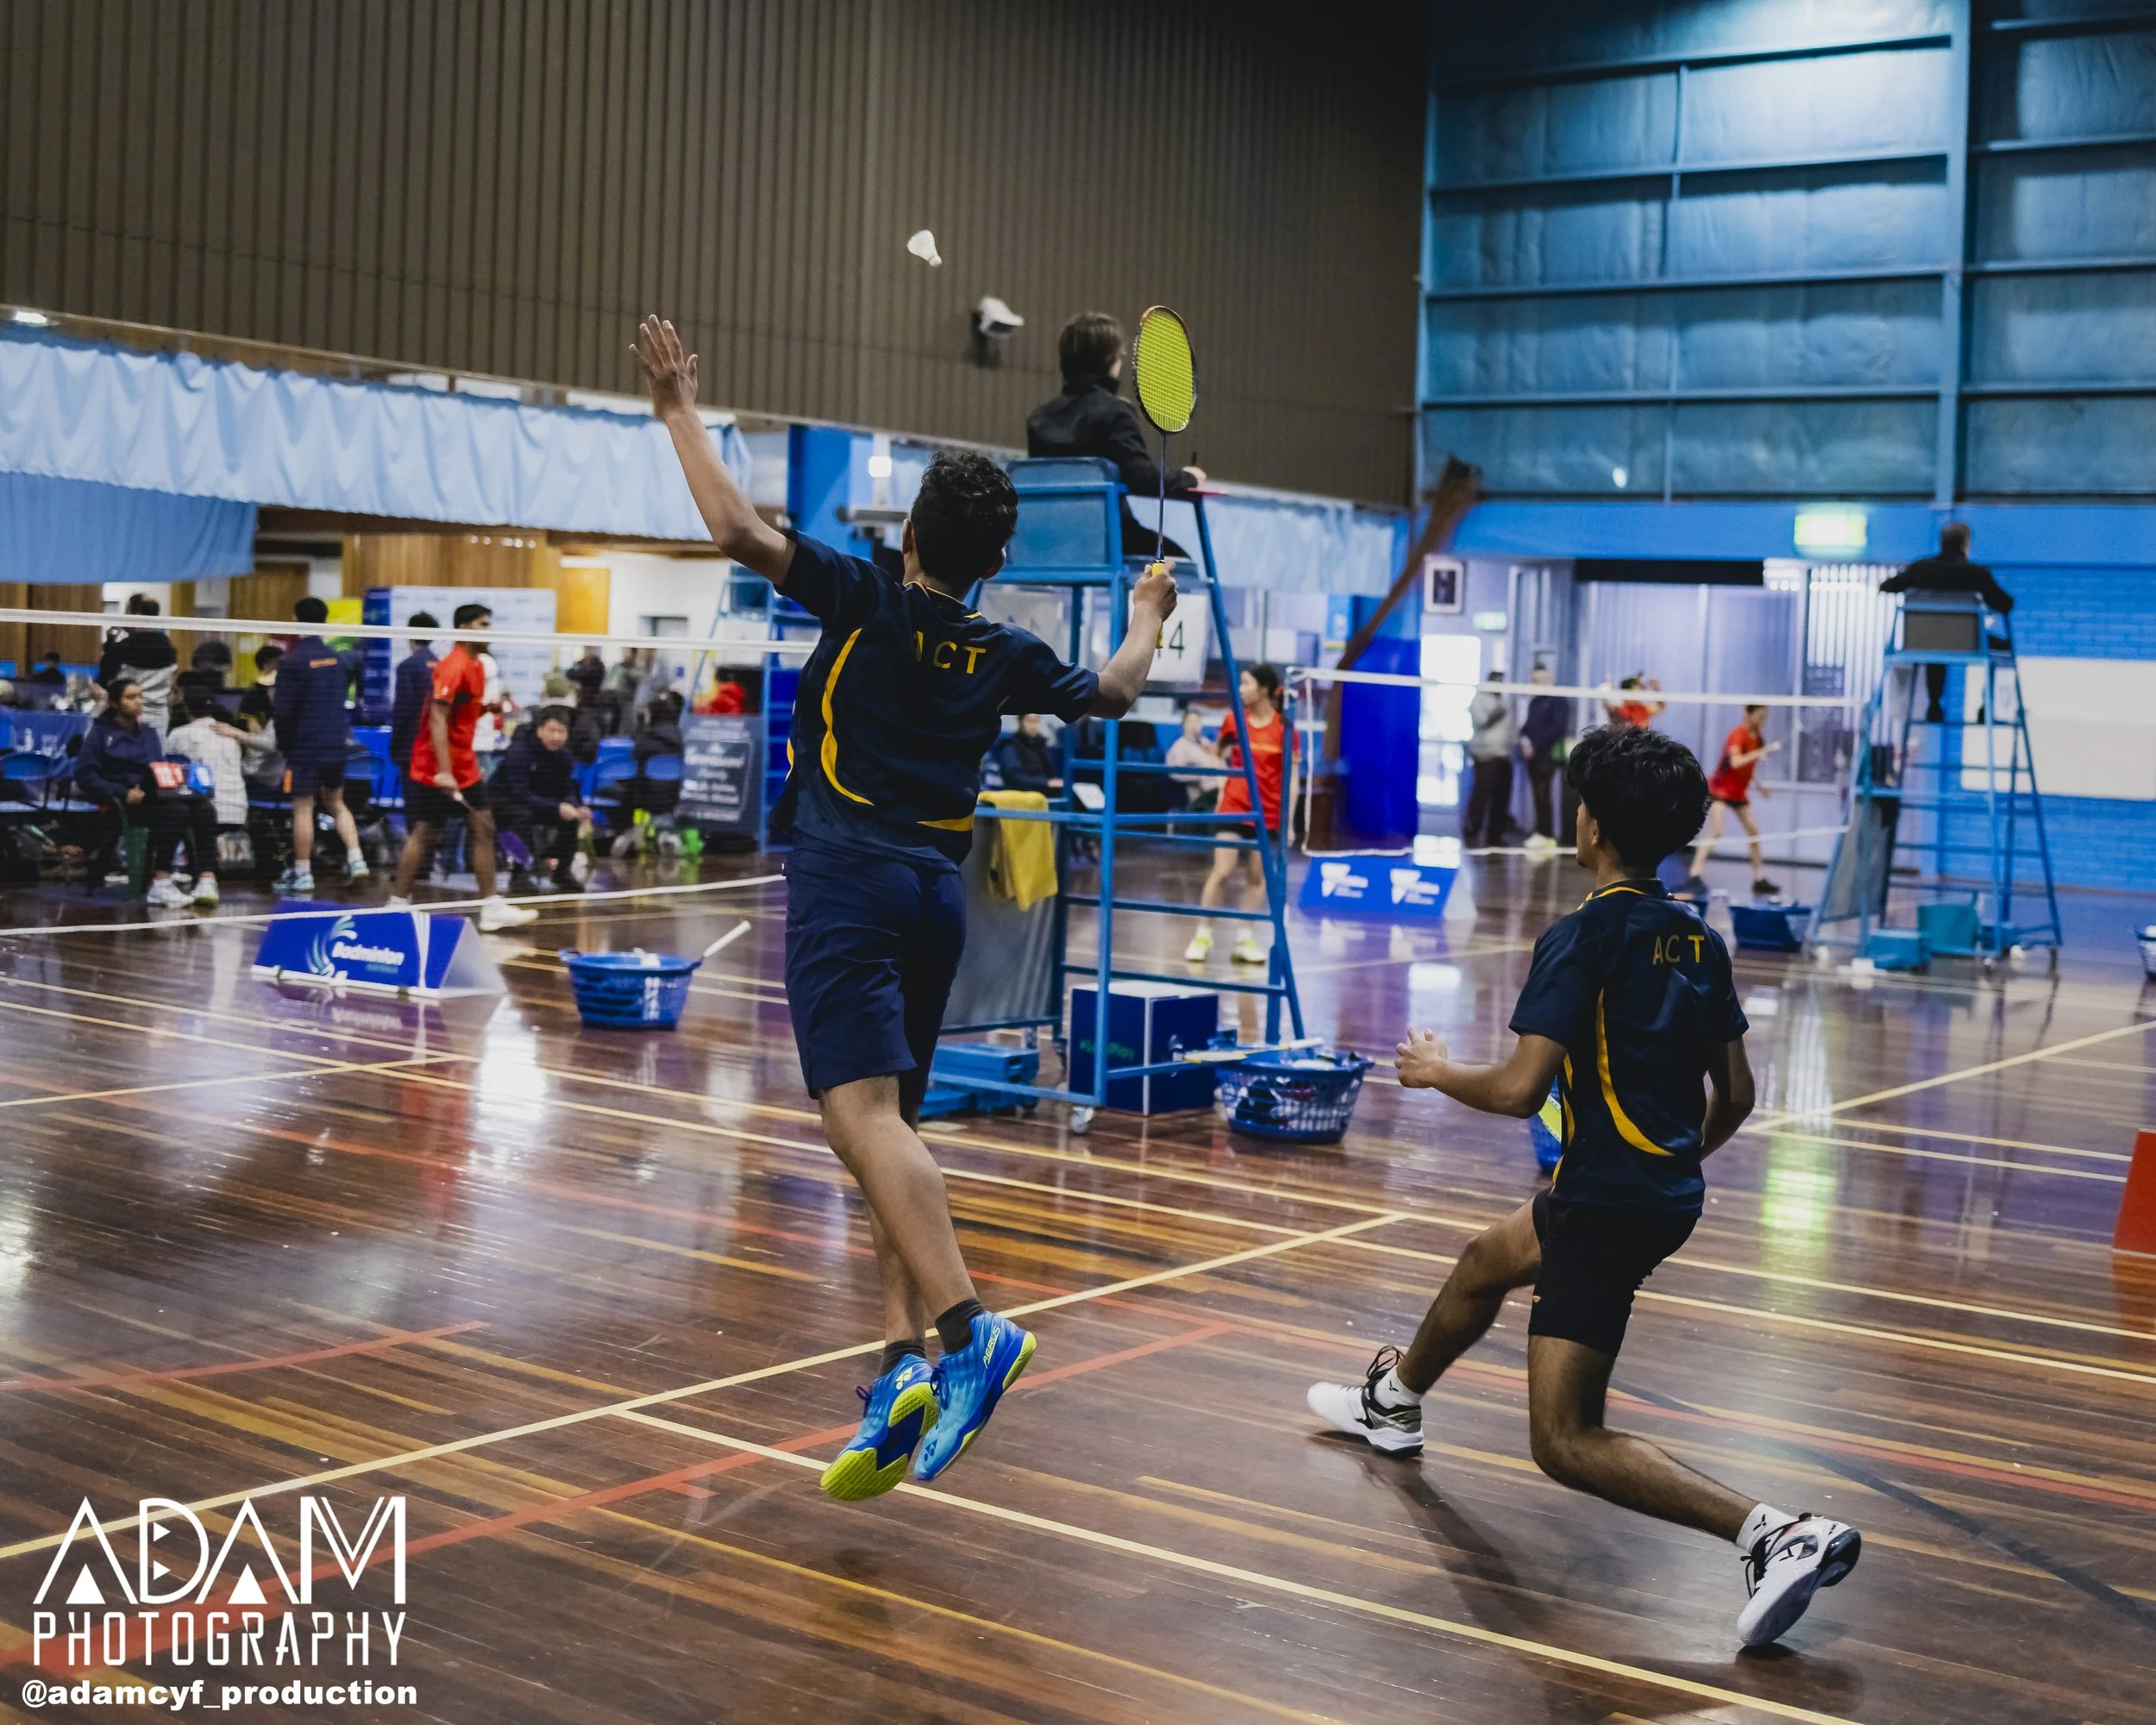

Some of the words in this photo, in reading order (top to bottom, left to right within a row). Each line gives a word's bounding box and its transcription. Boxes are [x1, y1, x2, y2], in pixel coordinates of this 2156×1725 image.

[1157, 620, 1186, 660] 4
[1652, 934, 1705, 965] ACT
[983, 1325, 1000, 1370] AERUS
